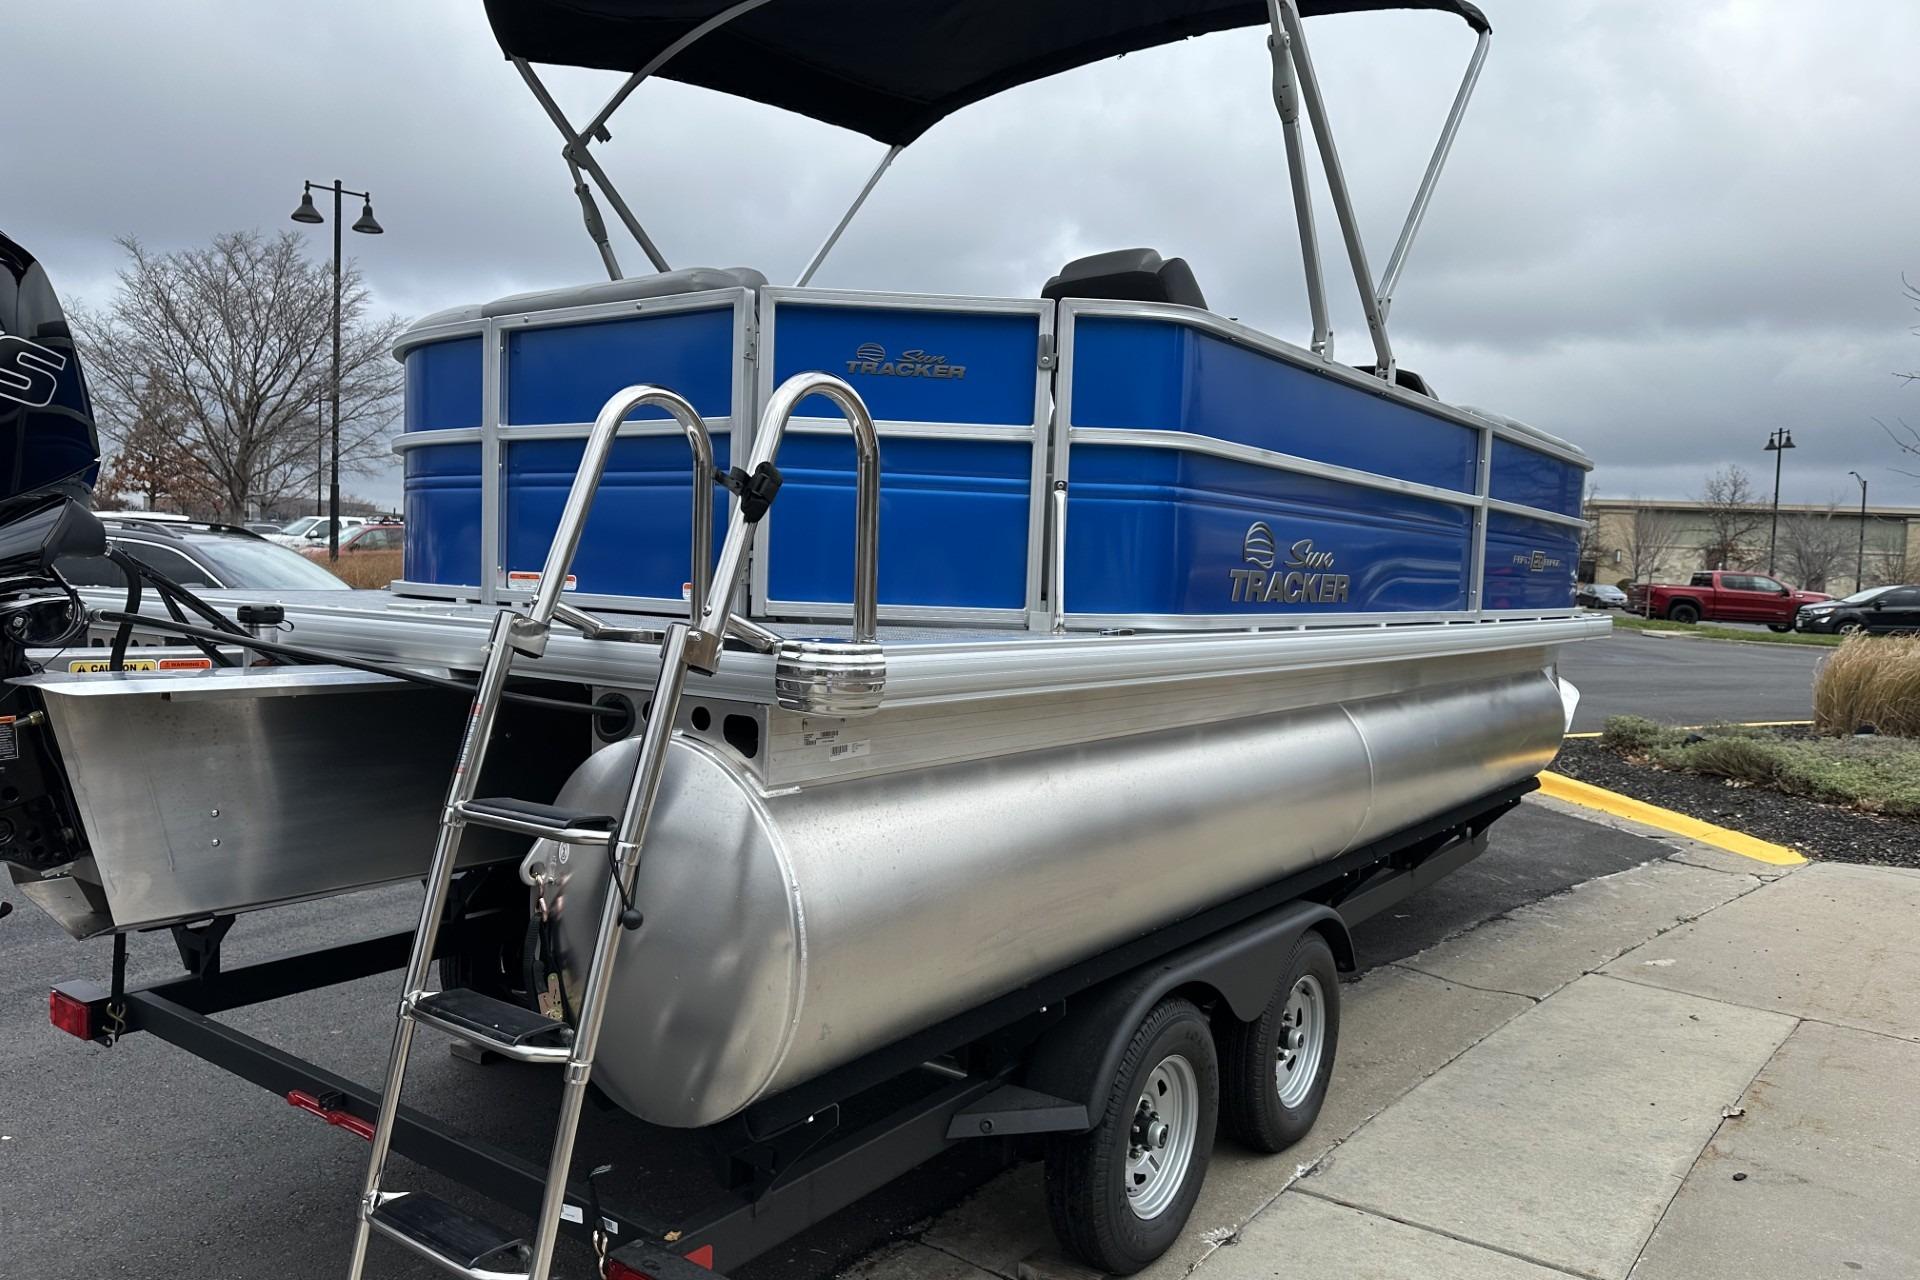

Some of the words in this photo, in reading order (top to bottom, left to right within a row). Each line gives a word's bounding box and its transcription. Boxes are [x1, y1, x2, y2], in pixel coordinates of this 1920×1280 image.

[895, 349, 947, 364] Sun
[846, 360, 966, 379] TRACKER
[1284, 539, 1335, 569] Sun
[1230, 569, 1350, 603] TRACKER
[91, 664, 136, 672] CAUON
